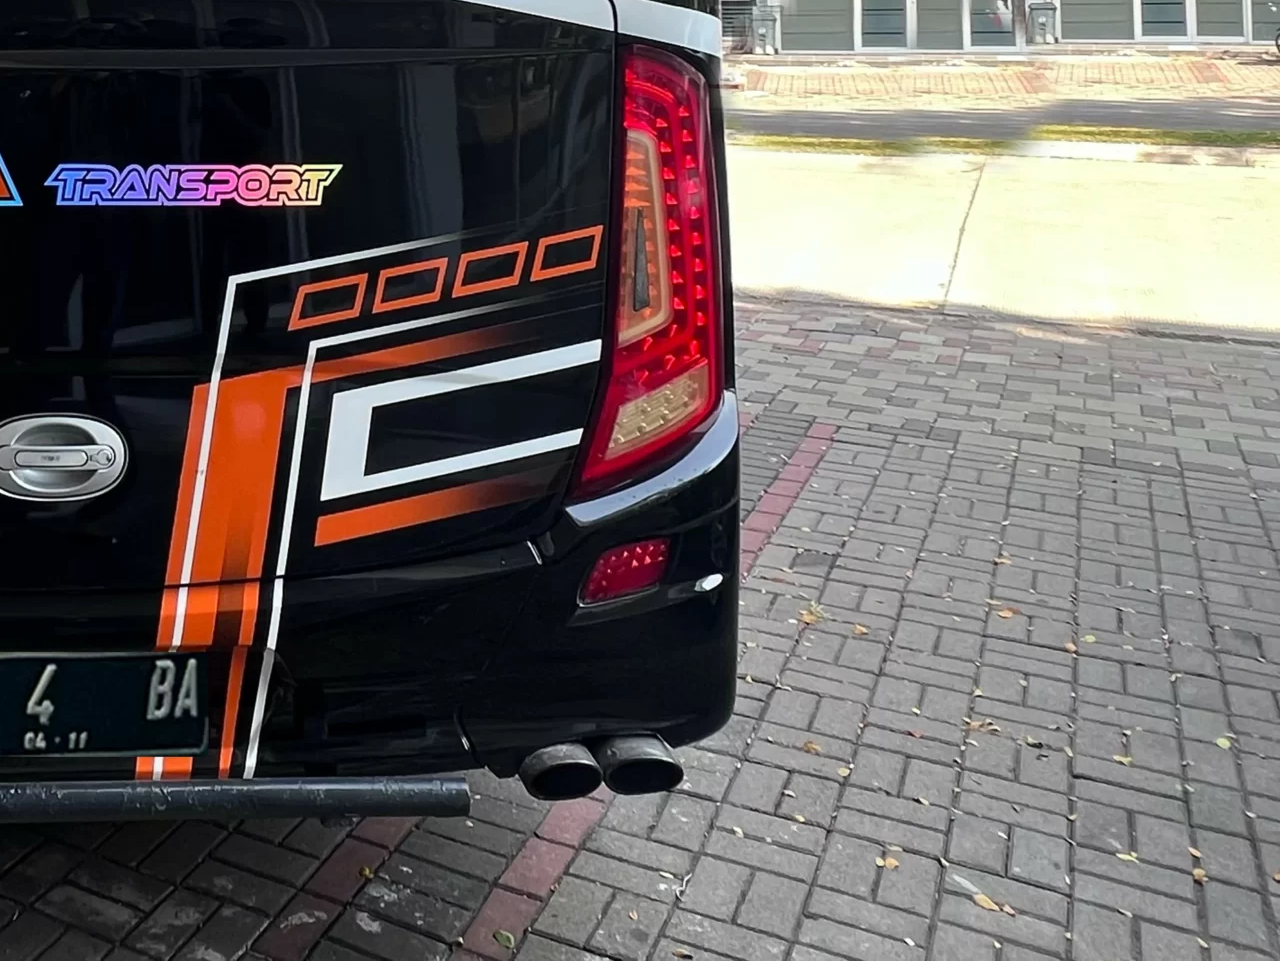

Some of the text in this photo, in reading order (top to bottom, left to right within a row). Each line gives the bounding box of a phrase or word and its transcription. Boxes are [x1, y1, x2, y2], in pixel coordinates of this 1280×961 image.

[45, 163, 342, 207] TRANSPORT
[26, 663, 57, 725] 4
[146, 658, 198, 720] BA
